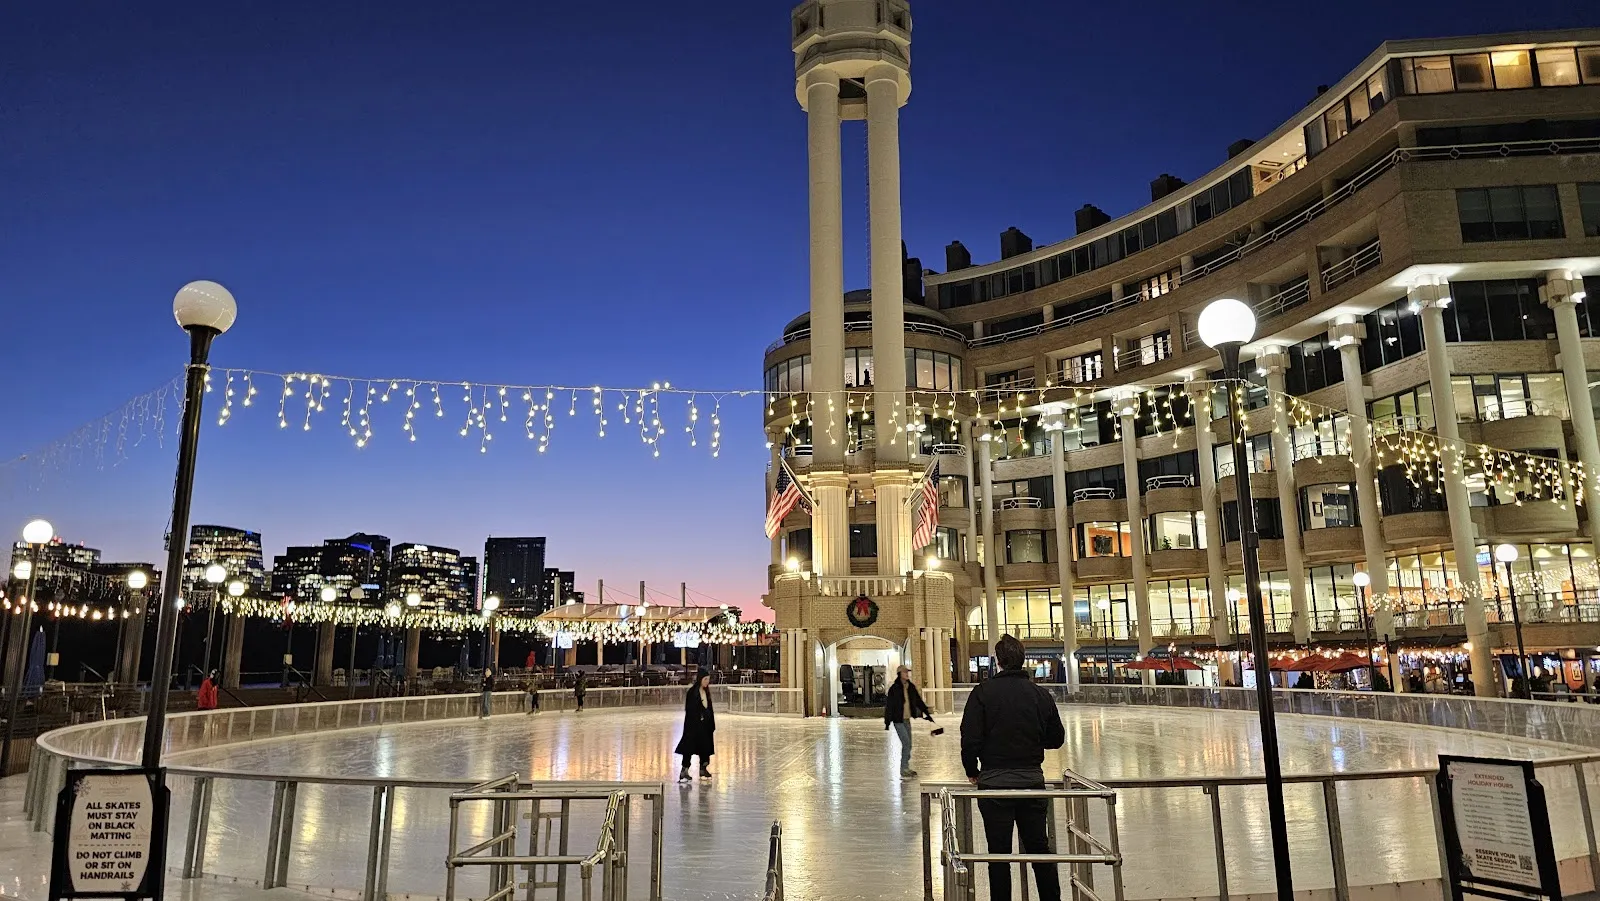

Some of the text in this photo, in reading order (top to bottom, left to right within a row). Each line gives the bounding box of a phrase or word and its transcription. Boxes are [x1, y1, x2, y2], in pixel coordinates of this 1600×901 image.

[1474, 773, 1505, 781] EXTENDED
[85, 801, 141, 810] ALL SKATES
[87, 812, 112, 820] MUST
[88, 822, 102, 830] ON
[90, 832, 132, 840] MATTING
[92, 851, 112, 859] NOT
[114, 851, 142, 859] CLIMB
[1475, 848, 1499, 857] RESERVE
[85, 861, 132, 869] OR SIT ON
[1494, 857, 1518, 866] SESSION
[80, 871, 135, 880] HANDRAILS
